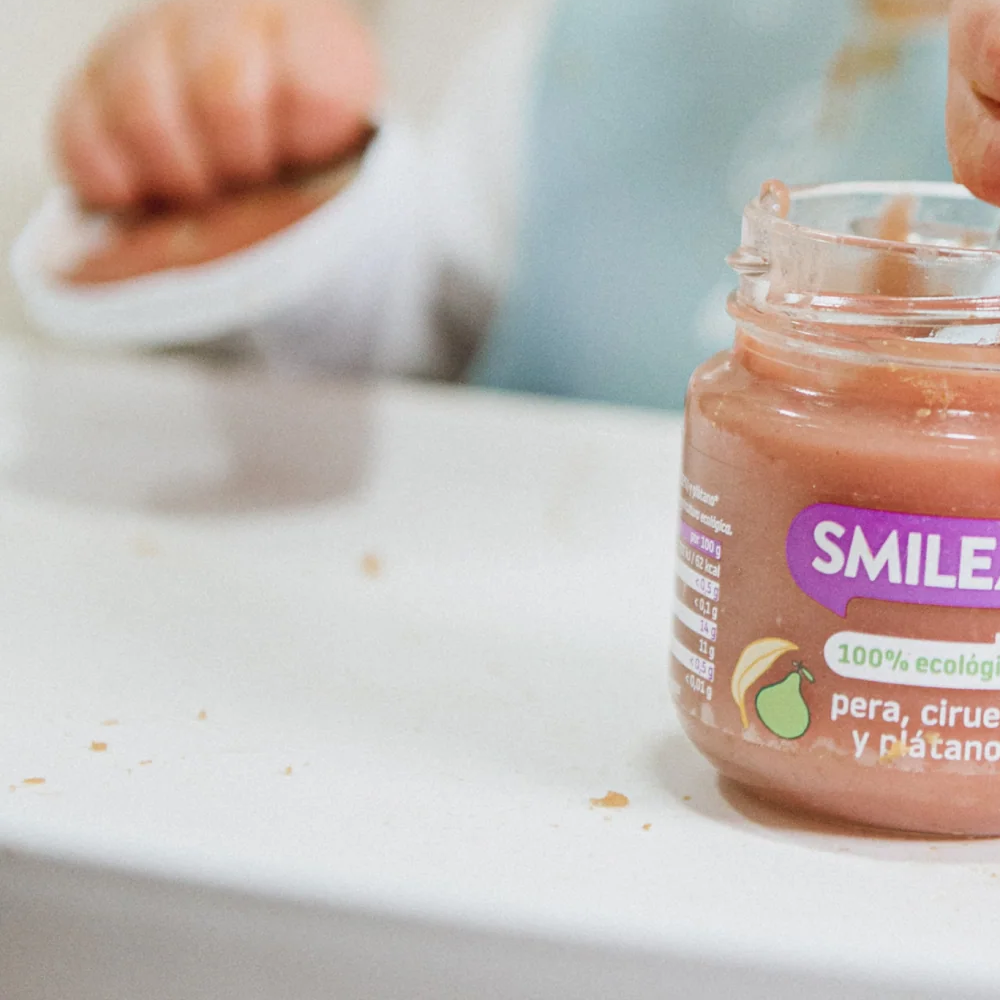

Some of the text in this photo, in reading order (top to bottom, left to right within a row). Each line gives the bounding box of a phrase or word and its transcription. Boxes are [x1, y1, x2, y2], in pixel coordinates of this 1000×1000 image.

[701, 535, 715, 553] 100
[715, 544, 722, 560] g
[704, 558, 721, 578] kcal
[713, 586, 720, 602] g
[711, 606, 718, 621] g
[711, 626, 718, 641] g
[699, 639, 715, 660] 11 g
[837, 643, 909, 672] 100%
[707, 665, 715, 681] g
[706, 685, 713, 701] g
[830, 692, 910, 729] pera,
[851, 729, 870, 759] y
